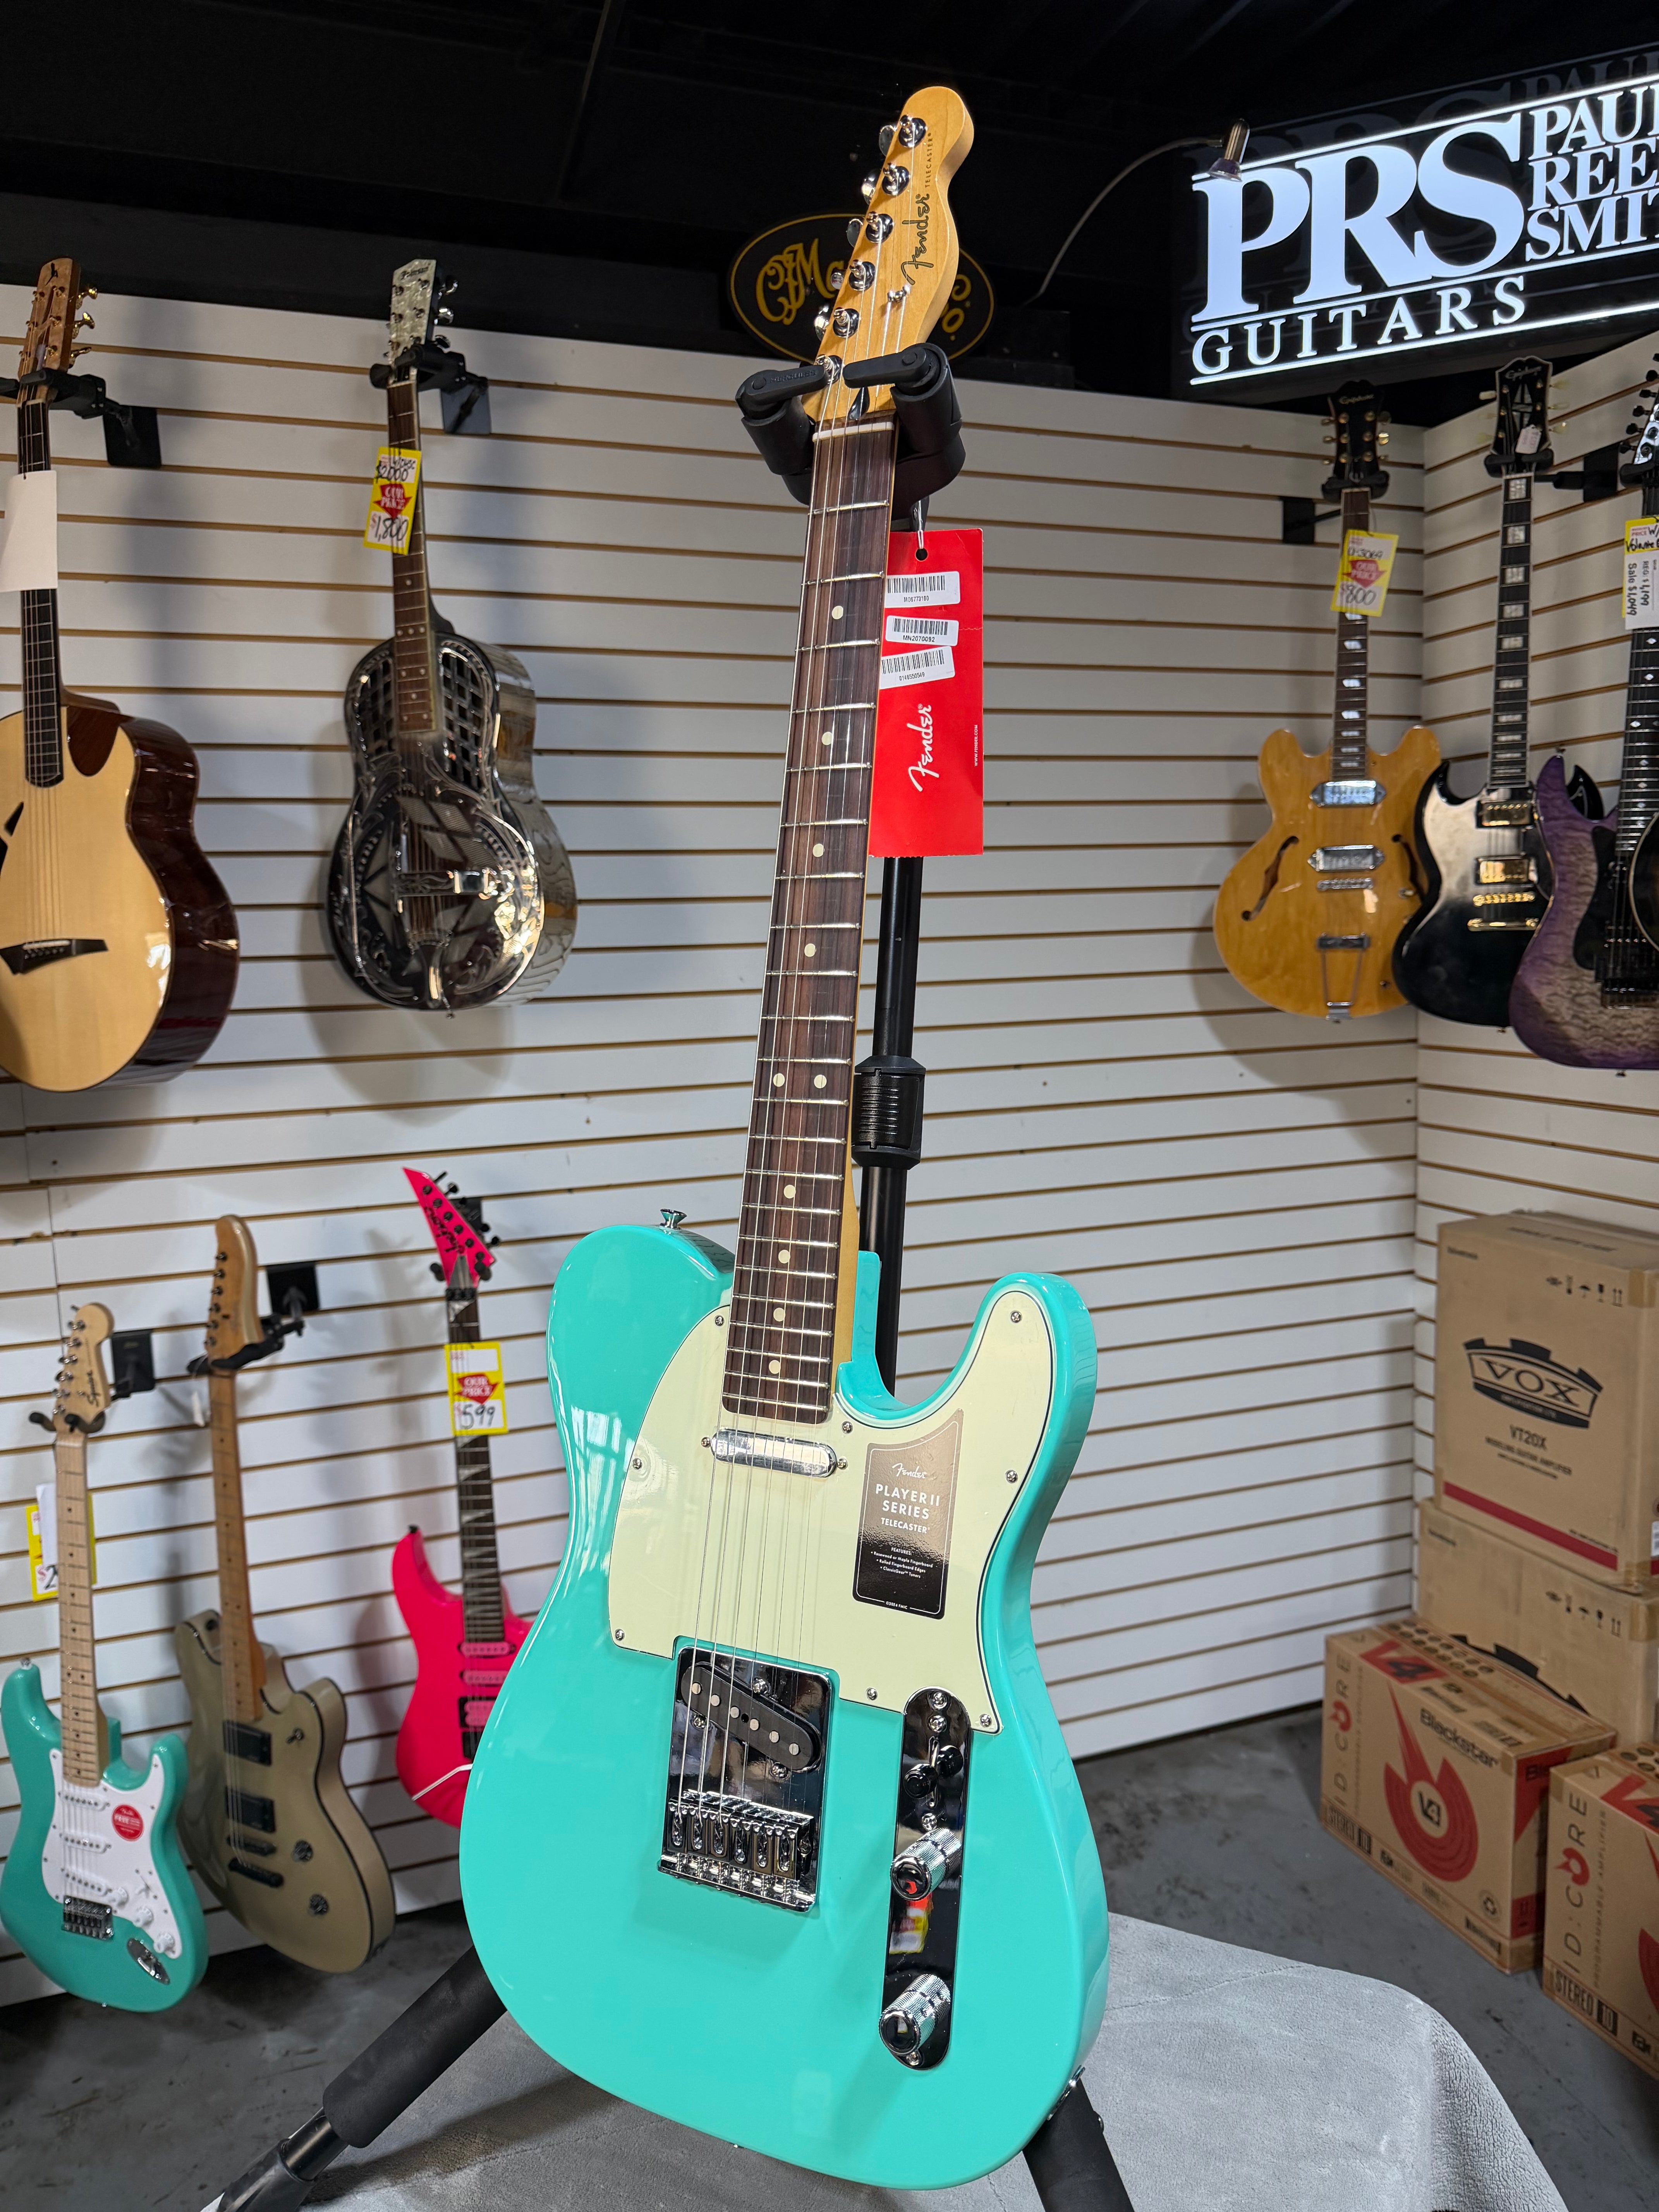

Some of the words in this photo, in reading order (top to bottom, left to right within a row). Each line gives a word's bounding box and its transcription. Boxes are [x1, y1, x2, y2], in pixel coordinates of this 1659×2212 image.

[1527, 137, 1659, 211] REE
[1192, 112, 1525, 322] PRS
[1525, 188, 1659, 262] SMI
[901, 193, 934, 285] Fender
[1192, 275, 1526, 375] GUITARS
[769, 369, 817, 383] HERCULES
[1628, 563, 1637, 584] Sale
[907, 704, 939, 792] Fender
[462, 1385, 493, 1397] PRICE
[463, 1376, 488, 1387] OUR
[1480, 1357, 1580, 1408] VOX
[1510, 1424, 1548, 1451] VT20X
[892, 1463, 927, 1479] Fender
[876, 1484, 927, 1504] PLAYER
[930, 1494, 939, 1506] II
[882, 1500, 929, 1519] SERIES
[891, 1561, 914, 1570] Fingerboard
[910, 1559, 933, 1568] Fingerboard
[1420, 1707, 1499, 1768] Blackstar
[1329, 1805, 1355, 1841] STEREO
[1555, 1970, 1594, 2016] STEREO
